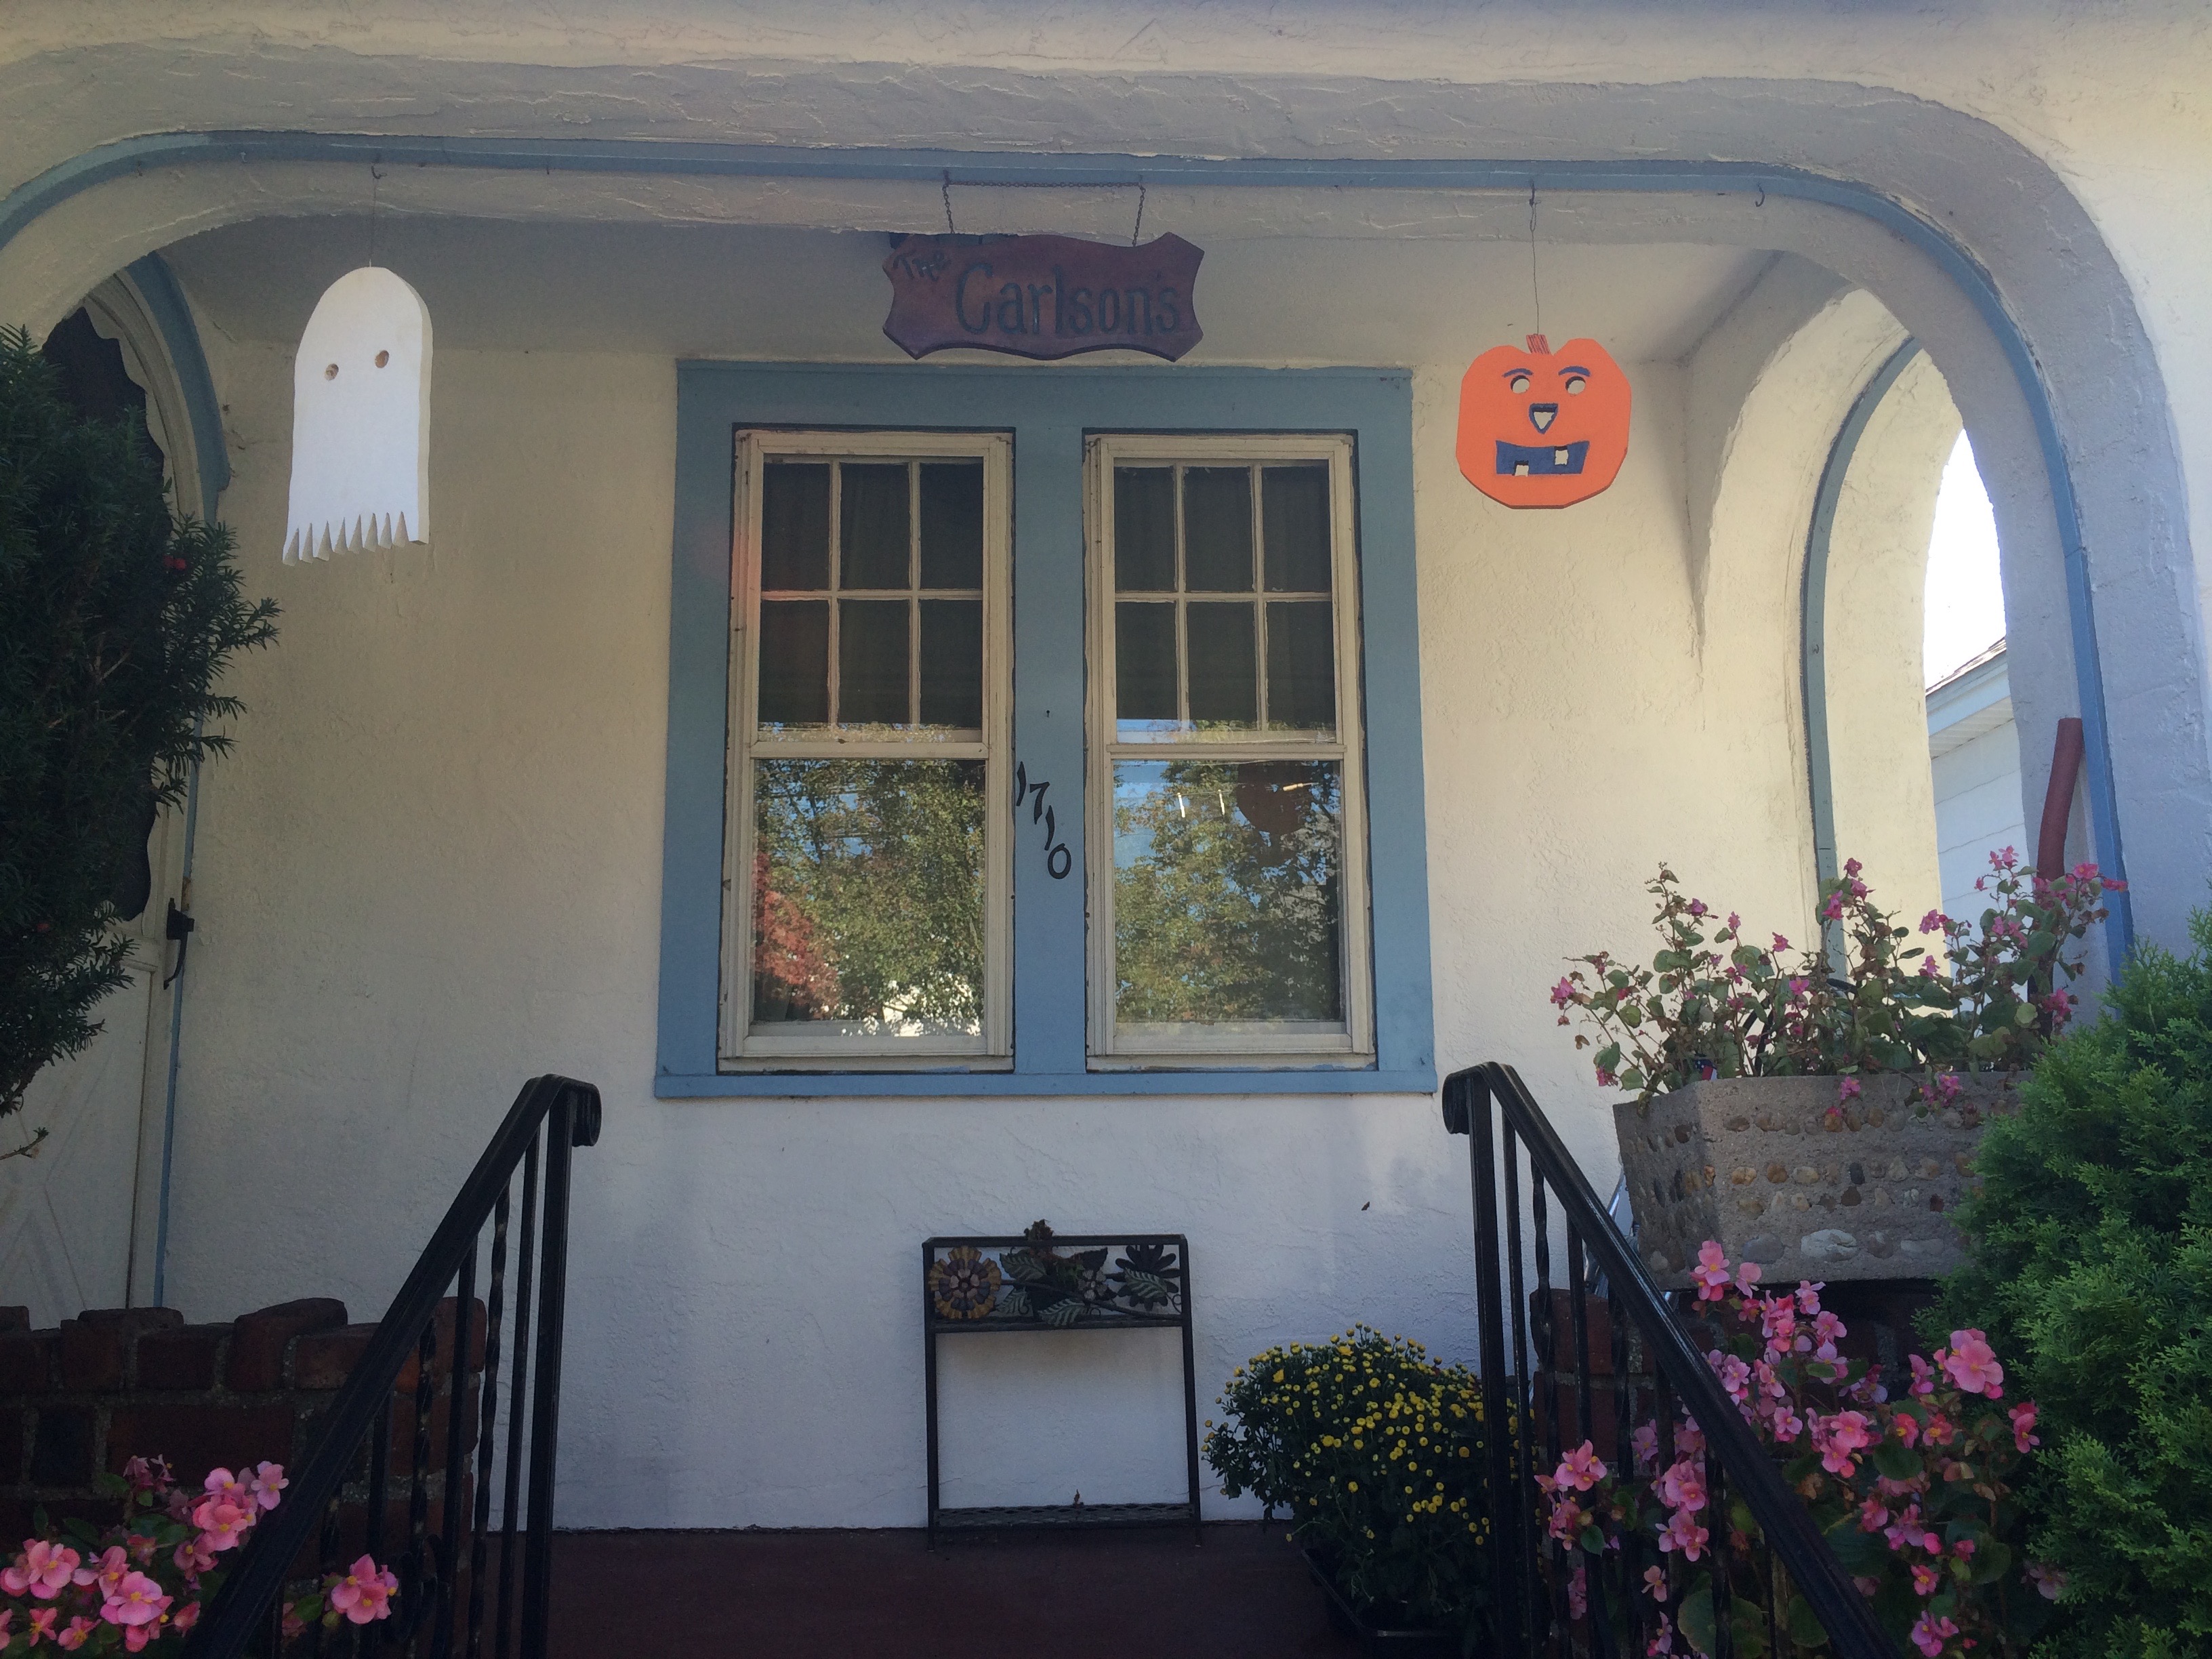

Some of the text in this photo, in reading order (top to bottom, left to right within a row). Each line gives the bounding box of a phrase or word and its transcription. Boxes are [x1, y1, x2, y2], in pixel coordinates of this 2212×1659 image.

[893, 249, 1181, 336] The Carlson's
[1016, 760, 1072, 880] 1710
